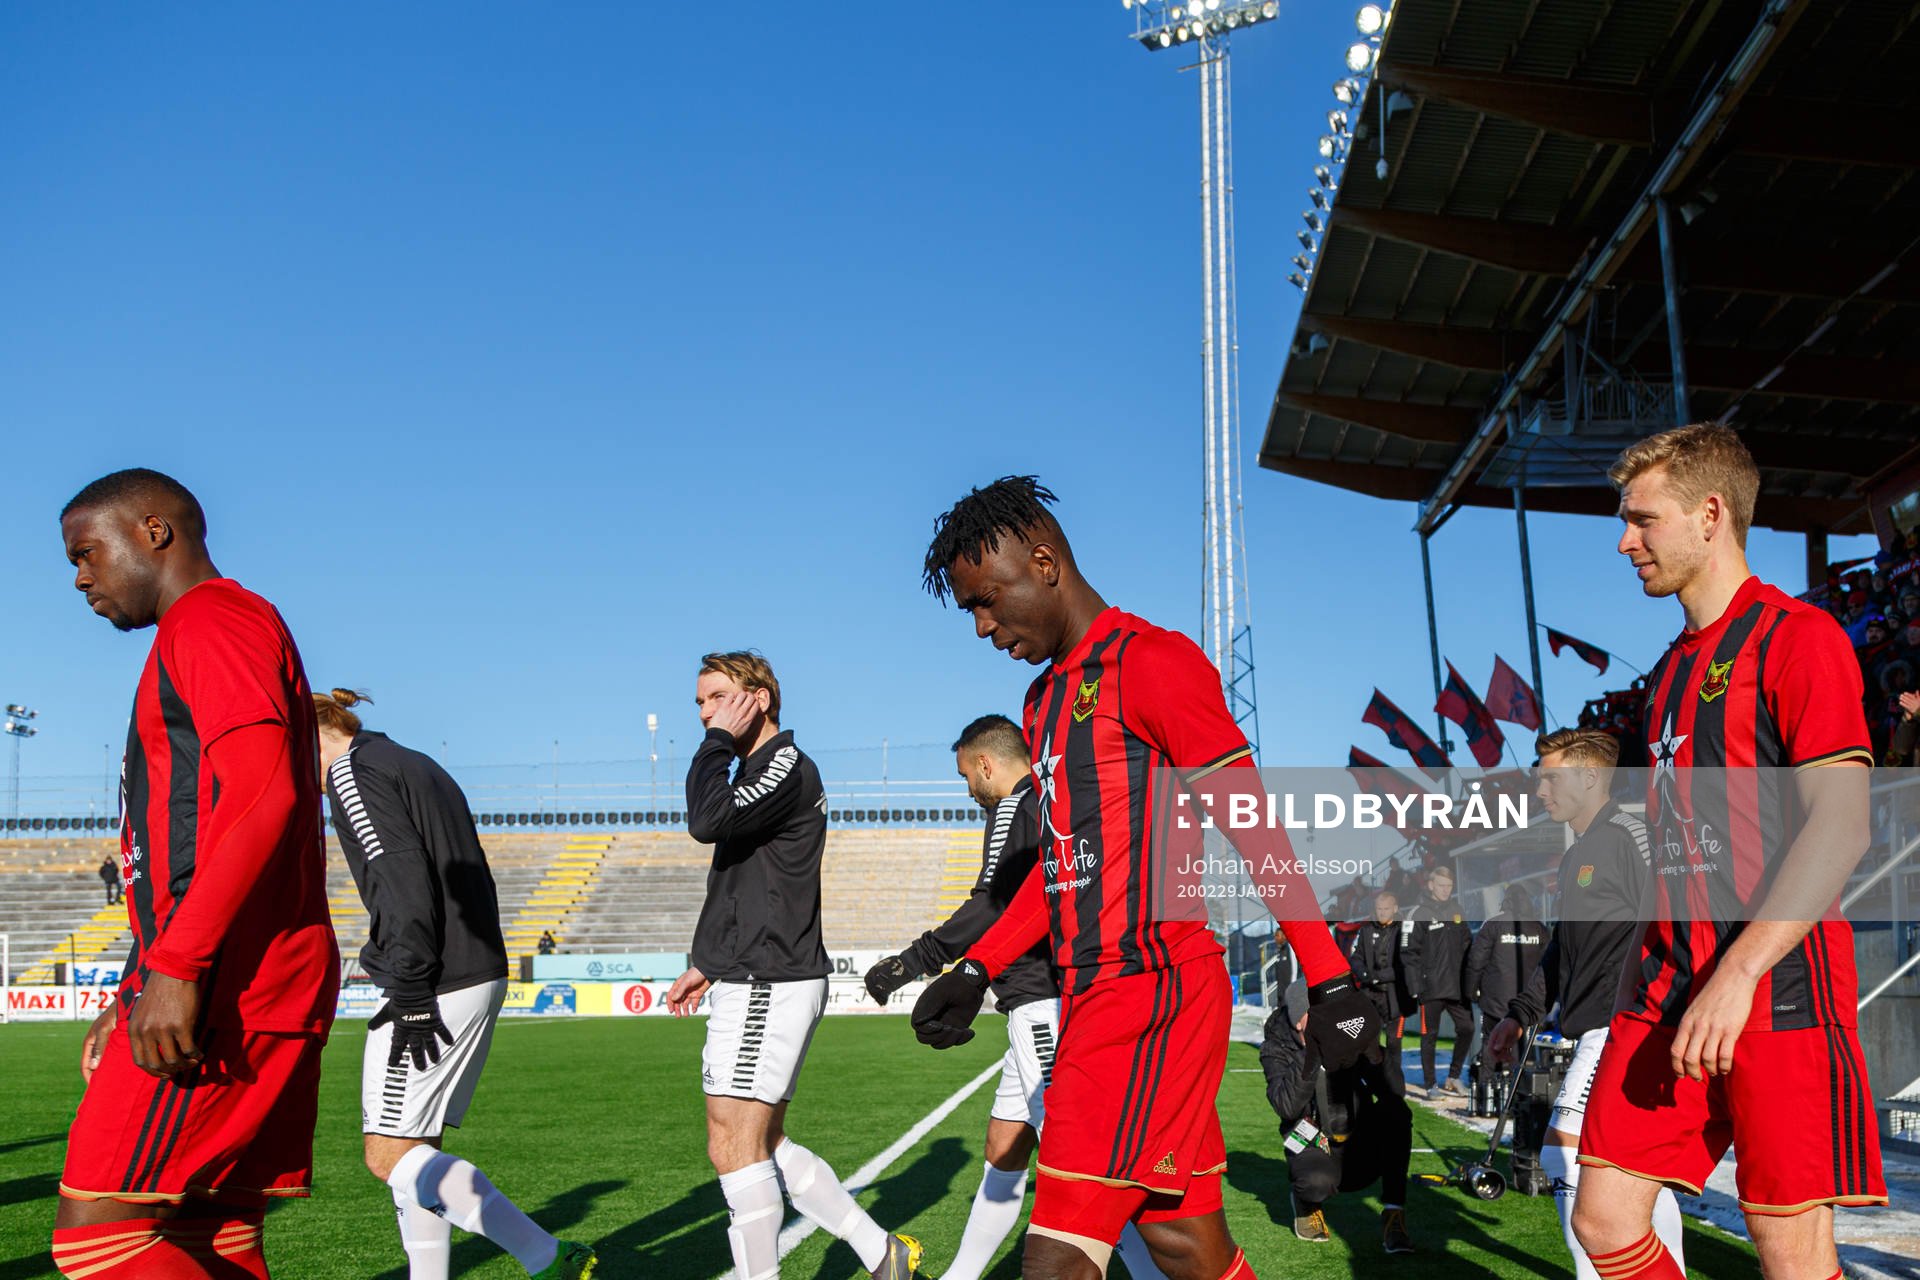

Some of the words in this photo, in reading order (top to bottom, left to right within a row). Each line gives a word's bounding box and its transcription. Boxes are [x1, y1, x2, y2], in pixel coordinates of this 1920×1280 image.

[1060, 838, 1098, 872] Life
[1501, 933, 1540, 945] stadium
[607, 963, 634, 974] SCA
[8, 991, 65, 1009] MAXI
[1153, 1165, 1178, 1175] adidas
